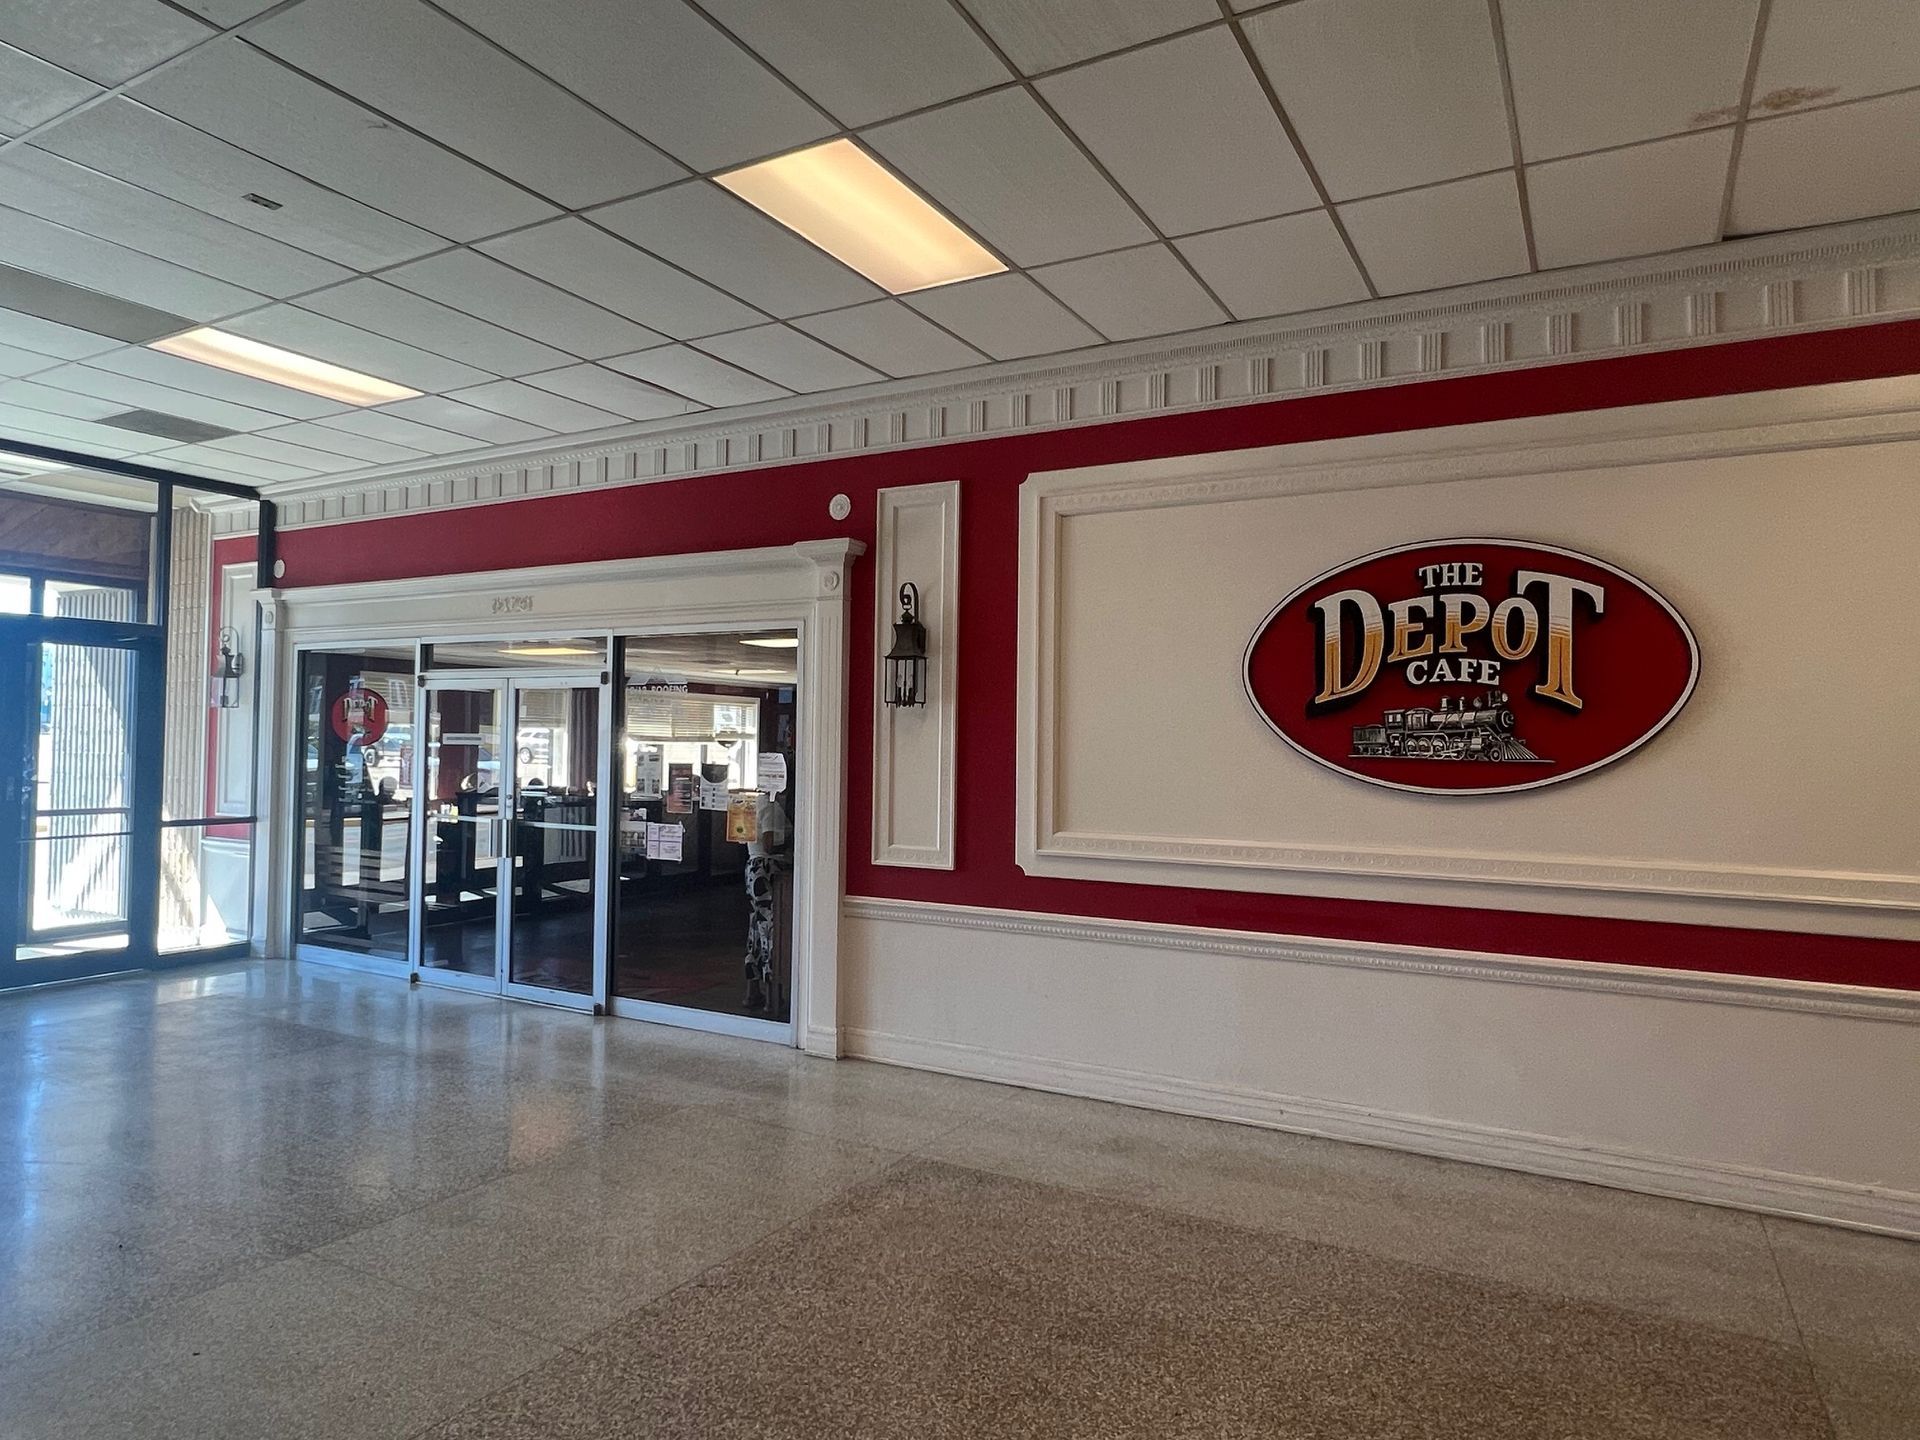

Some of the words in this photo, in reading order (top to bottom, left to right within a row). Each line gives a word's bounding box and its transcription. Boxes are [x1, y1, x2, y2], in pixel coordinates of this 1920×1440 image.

[1418, 562, 1483, 589] THE
[1314, 569, 1605, 709] DEPOT
[1406, 658, 1501, 686] CAFE
[342, 695, 379, 722] DEPOT
